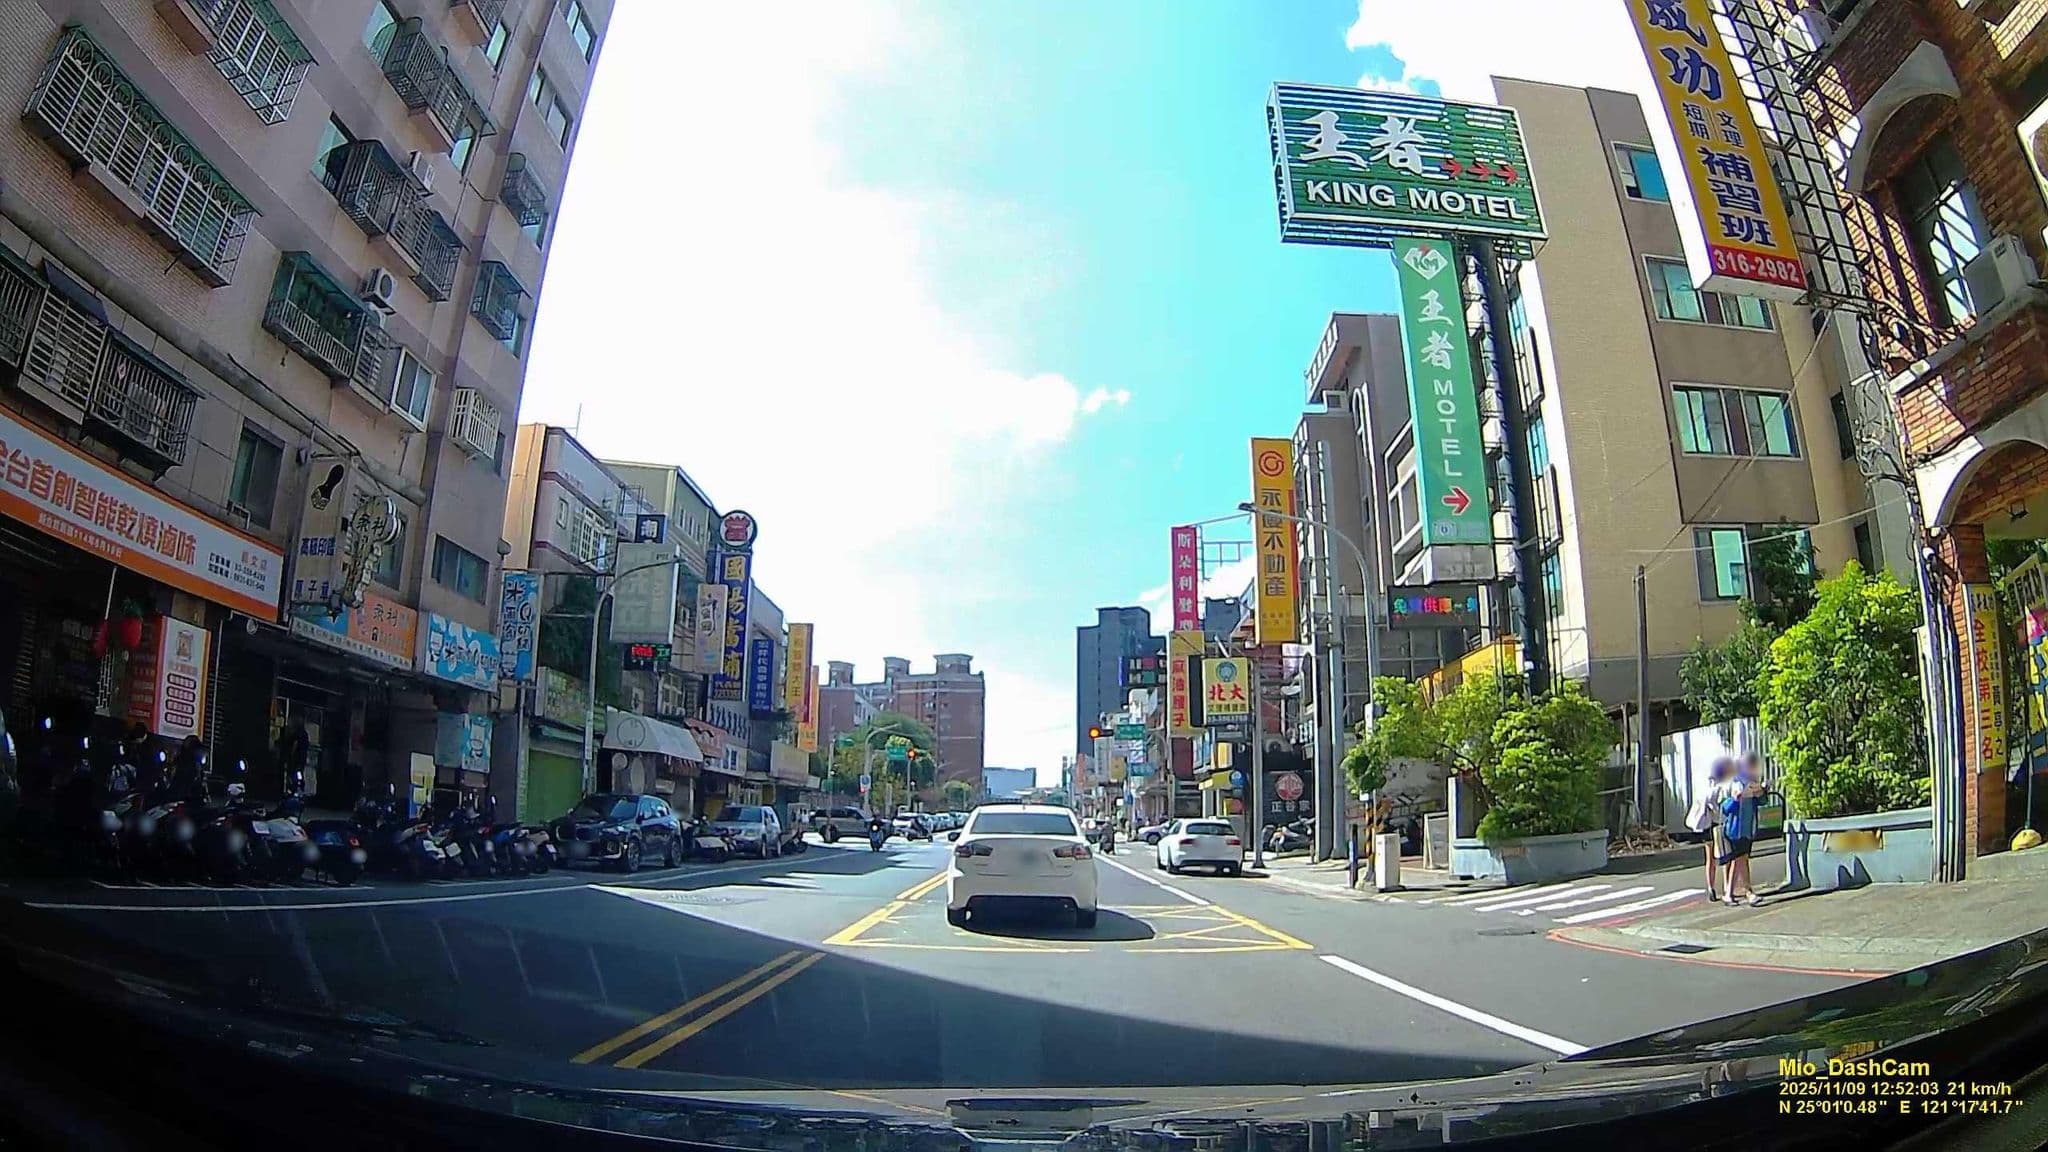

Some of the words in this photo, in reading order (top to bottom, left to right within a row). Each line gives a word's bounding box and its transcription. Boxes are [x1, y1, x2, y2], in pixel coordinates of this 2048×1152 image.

[1682, 102, 1711, 141] 短期
[1716, 110, 1745, 149] 文理
[1299, 110, 1428, 177] 王者
[1306, 180, 1398, 208] KING
[1408, 186, 1530, 220] MOTEL
[1697, 145, 1777, 248] 補習班
[1713, 248, 1801, 283] 316-2982
[1417, 289, 1455, 371] 王者
[1432, 379, 1463, 477] MOTEL
[1209, 683, 1246, 701] 北大
